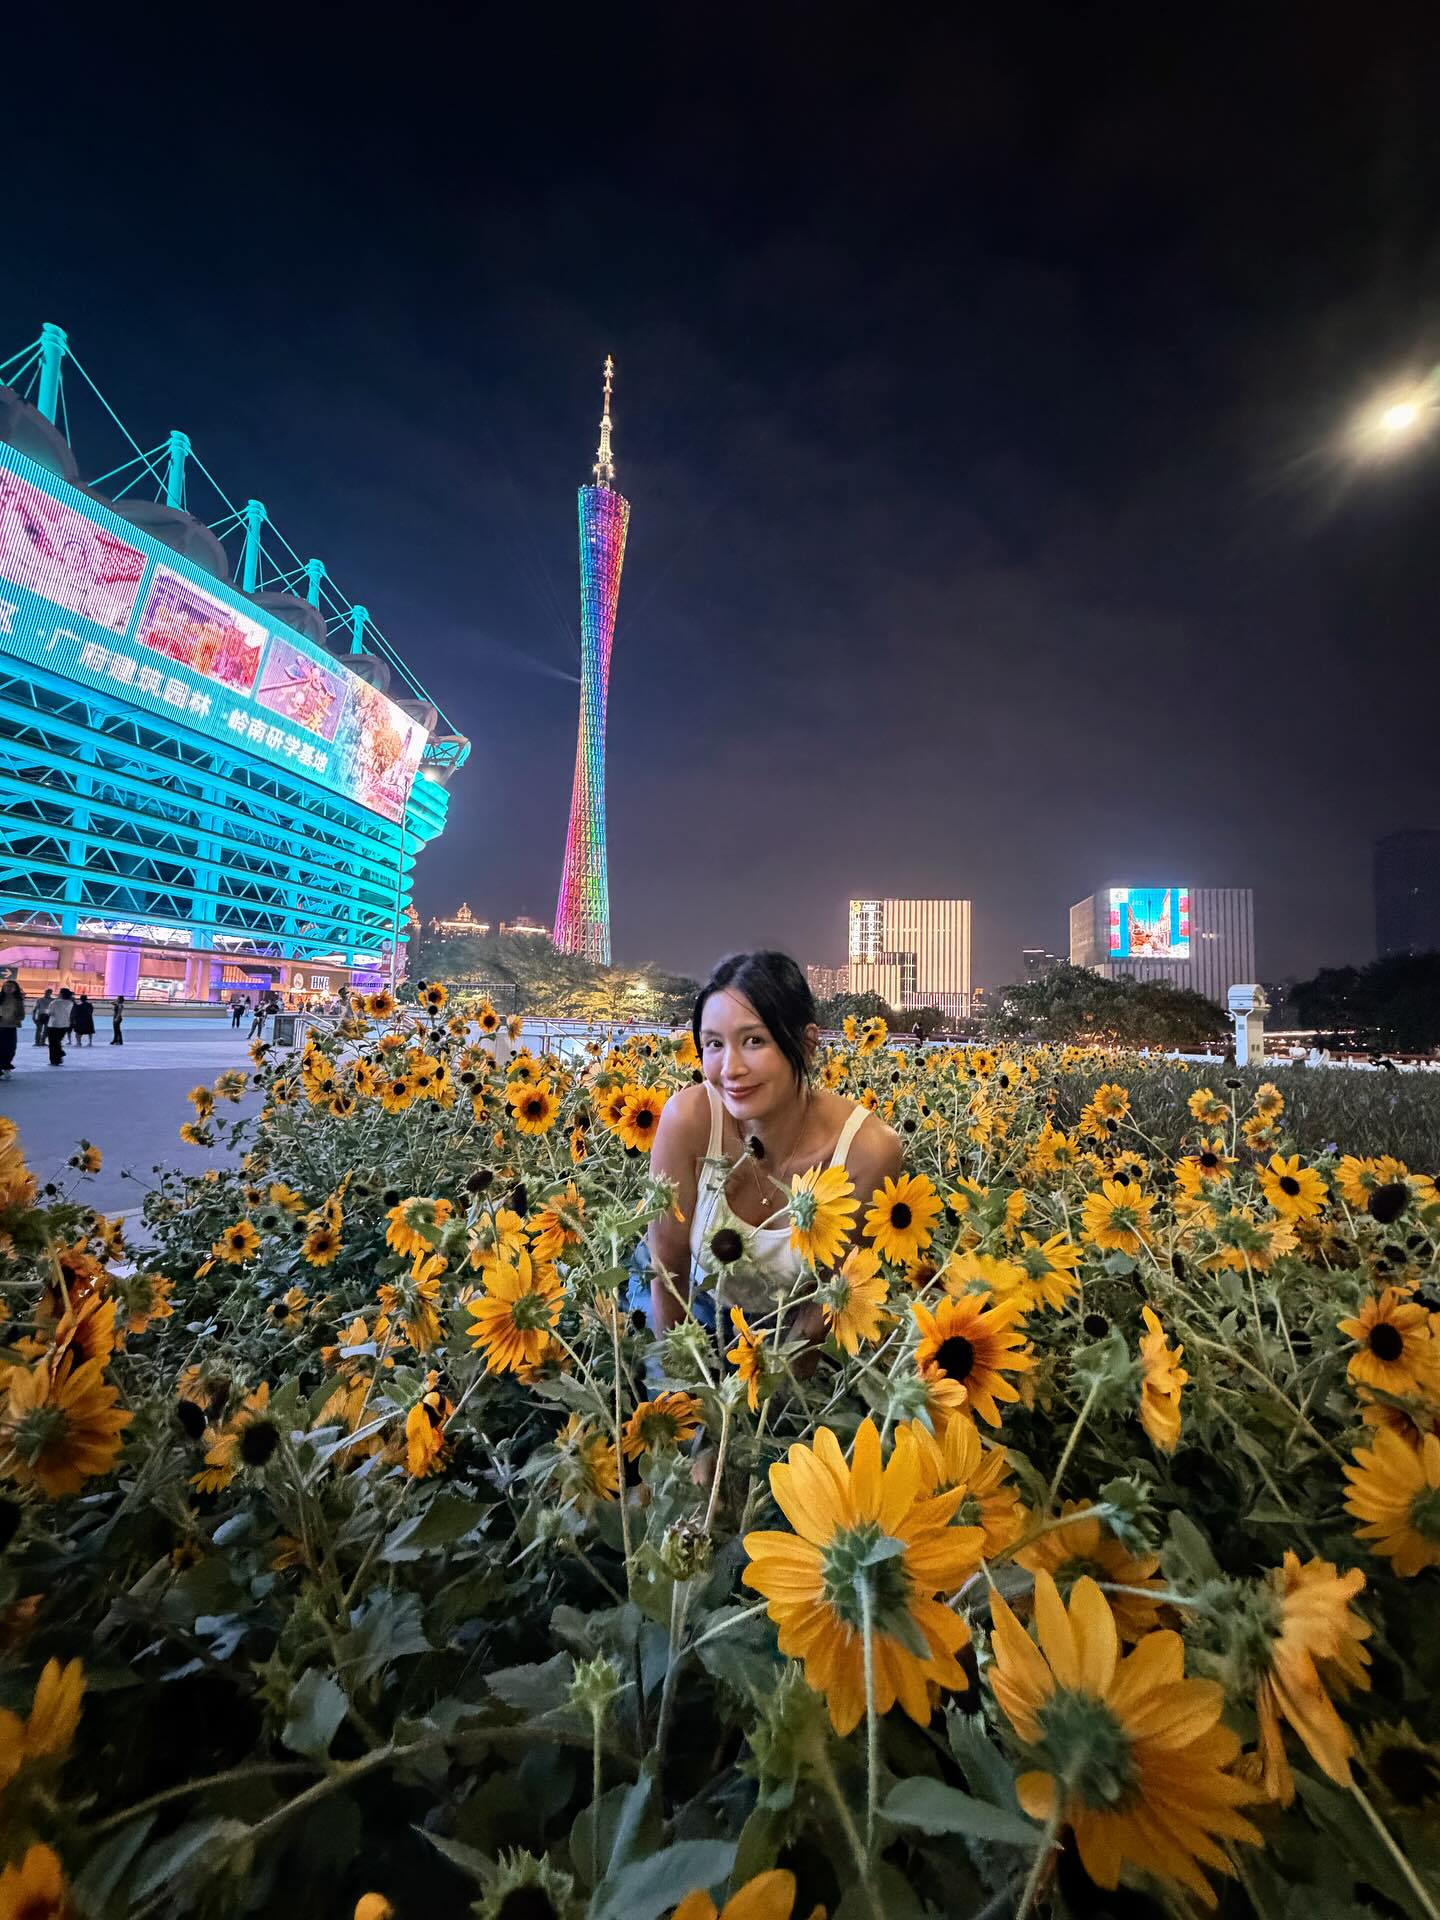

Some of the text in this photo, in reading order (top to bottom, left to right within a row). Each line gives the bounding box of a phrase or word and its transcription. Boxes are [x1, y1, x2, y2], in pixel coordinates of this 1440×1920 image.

[228, 708, 328, 774] 岭南研学基地
